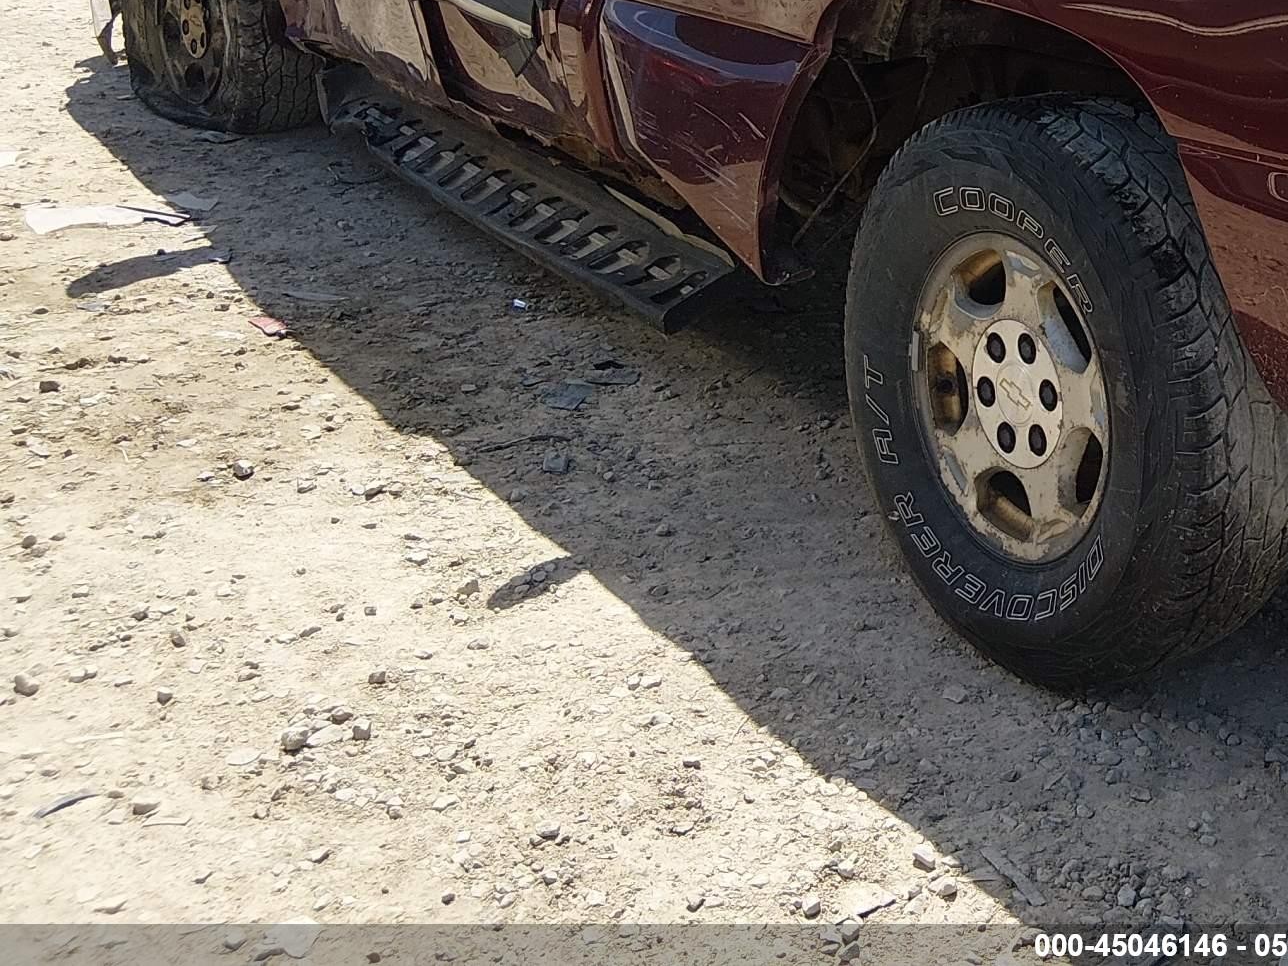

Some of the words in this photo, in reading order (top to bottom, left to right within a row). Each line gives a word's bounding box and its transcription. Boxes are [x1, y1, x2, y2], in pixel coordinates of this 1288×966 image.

[932, 185, 1094, 315] COOPER
[863, 354, 900, 466] A/T
[893, 490, 1105, 622] DISCOVERER
